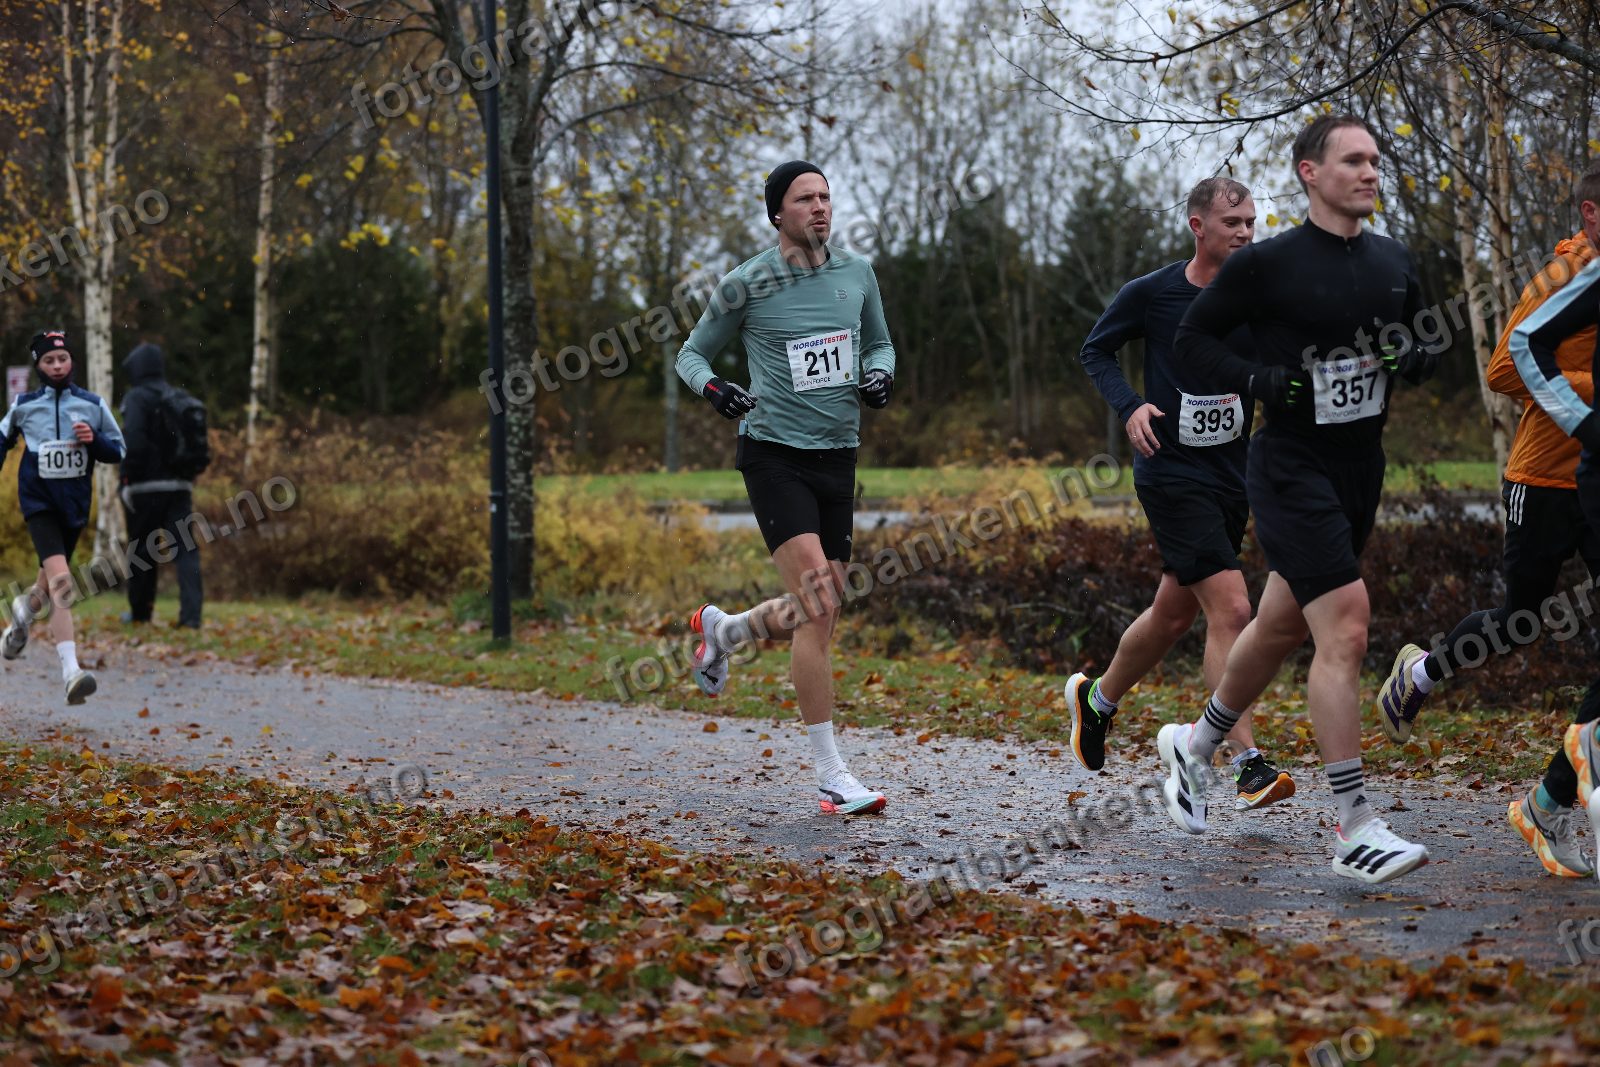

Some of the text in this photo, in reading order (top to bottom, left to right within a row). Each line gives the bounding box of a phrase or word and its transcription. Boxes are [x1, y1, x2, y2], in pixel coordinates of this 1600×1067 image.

[792, 334, 848, 351] NORGESTESTEN
[804, 346, 840, 377] 211
[1331, 371, 1378, 408] 357
[1192, 407, 1235, 434] 393
[44, 450, 84, 469] 1013
